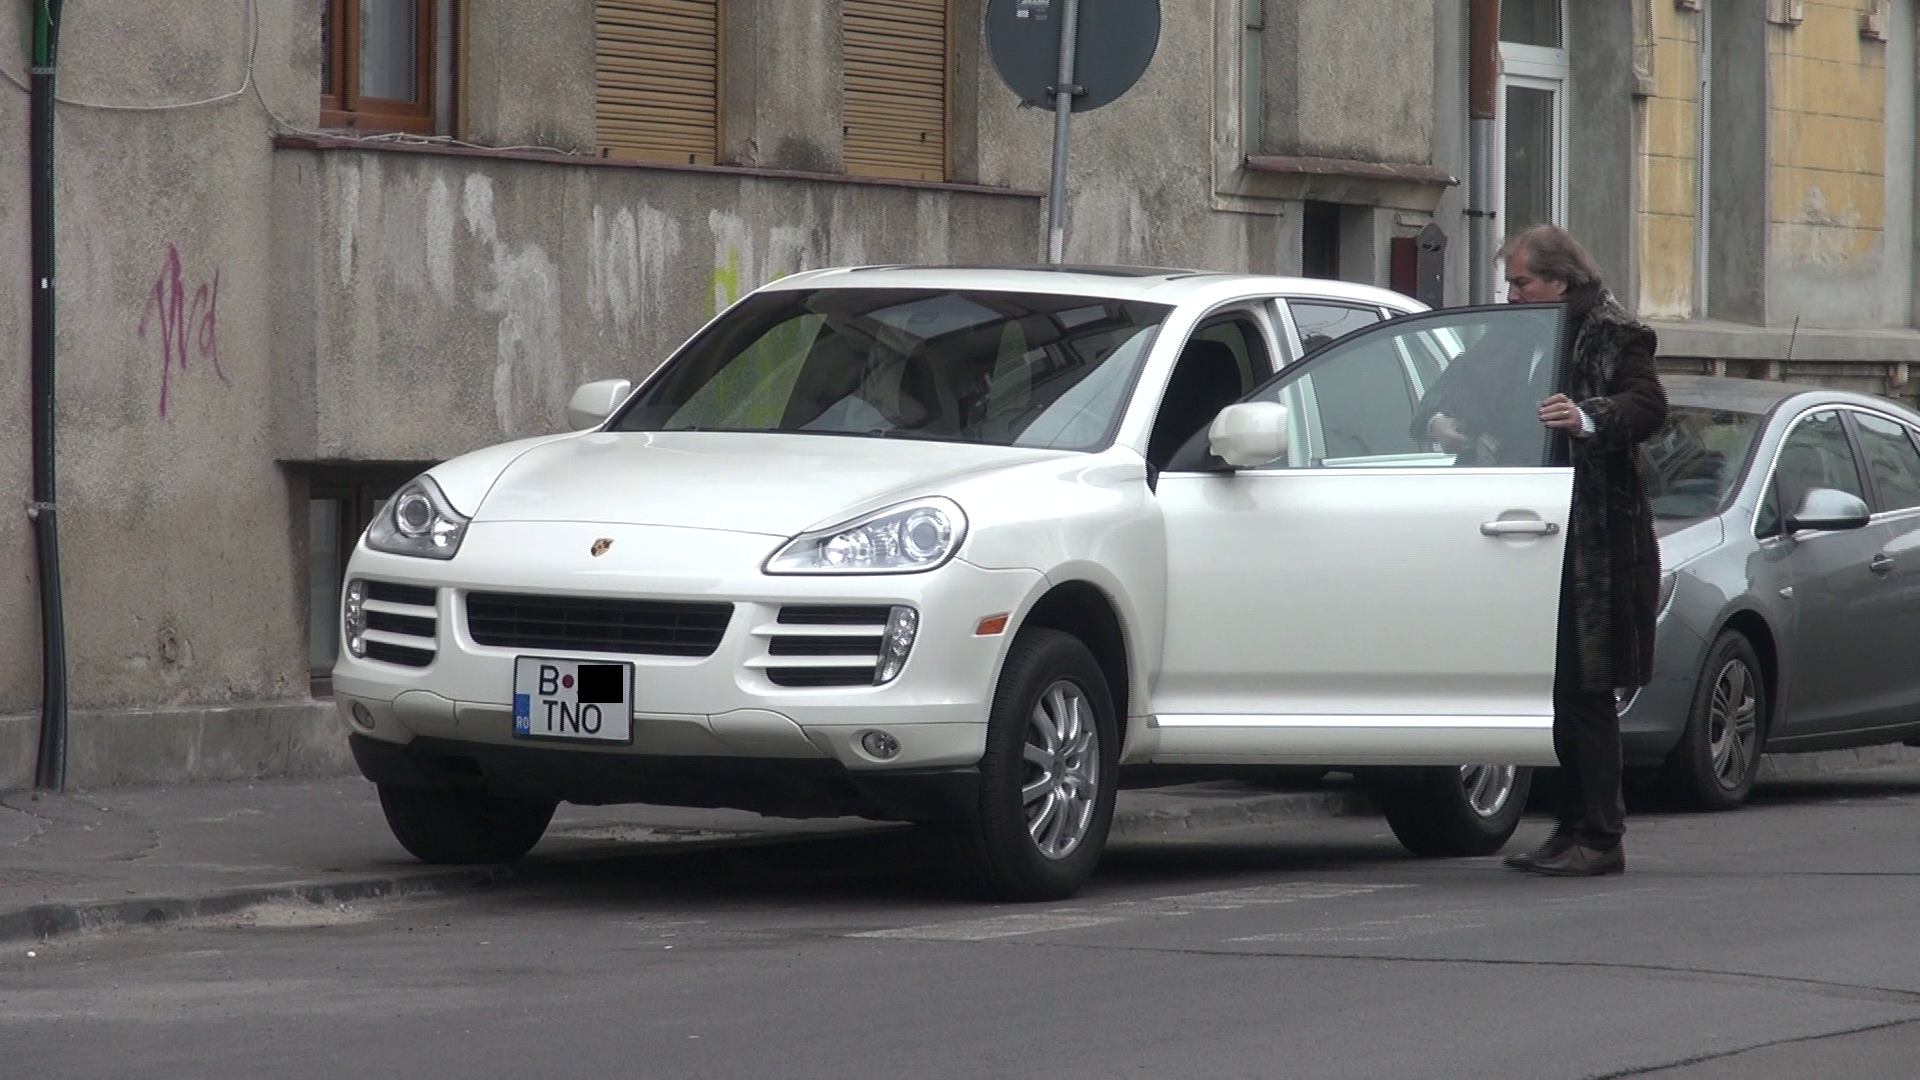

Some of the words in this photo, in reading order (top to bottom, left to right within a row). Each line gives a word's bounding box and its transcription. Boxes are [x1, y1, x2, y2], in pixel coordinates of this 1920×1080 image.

[539, 665, 559, 695] B
[516, 715, 529, 729] RO
[543, 700, 602, 734] TNO
